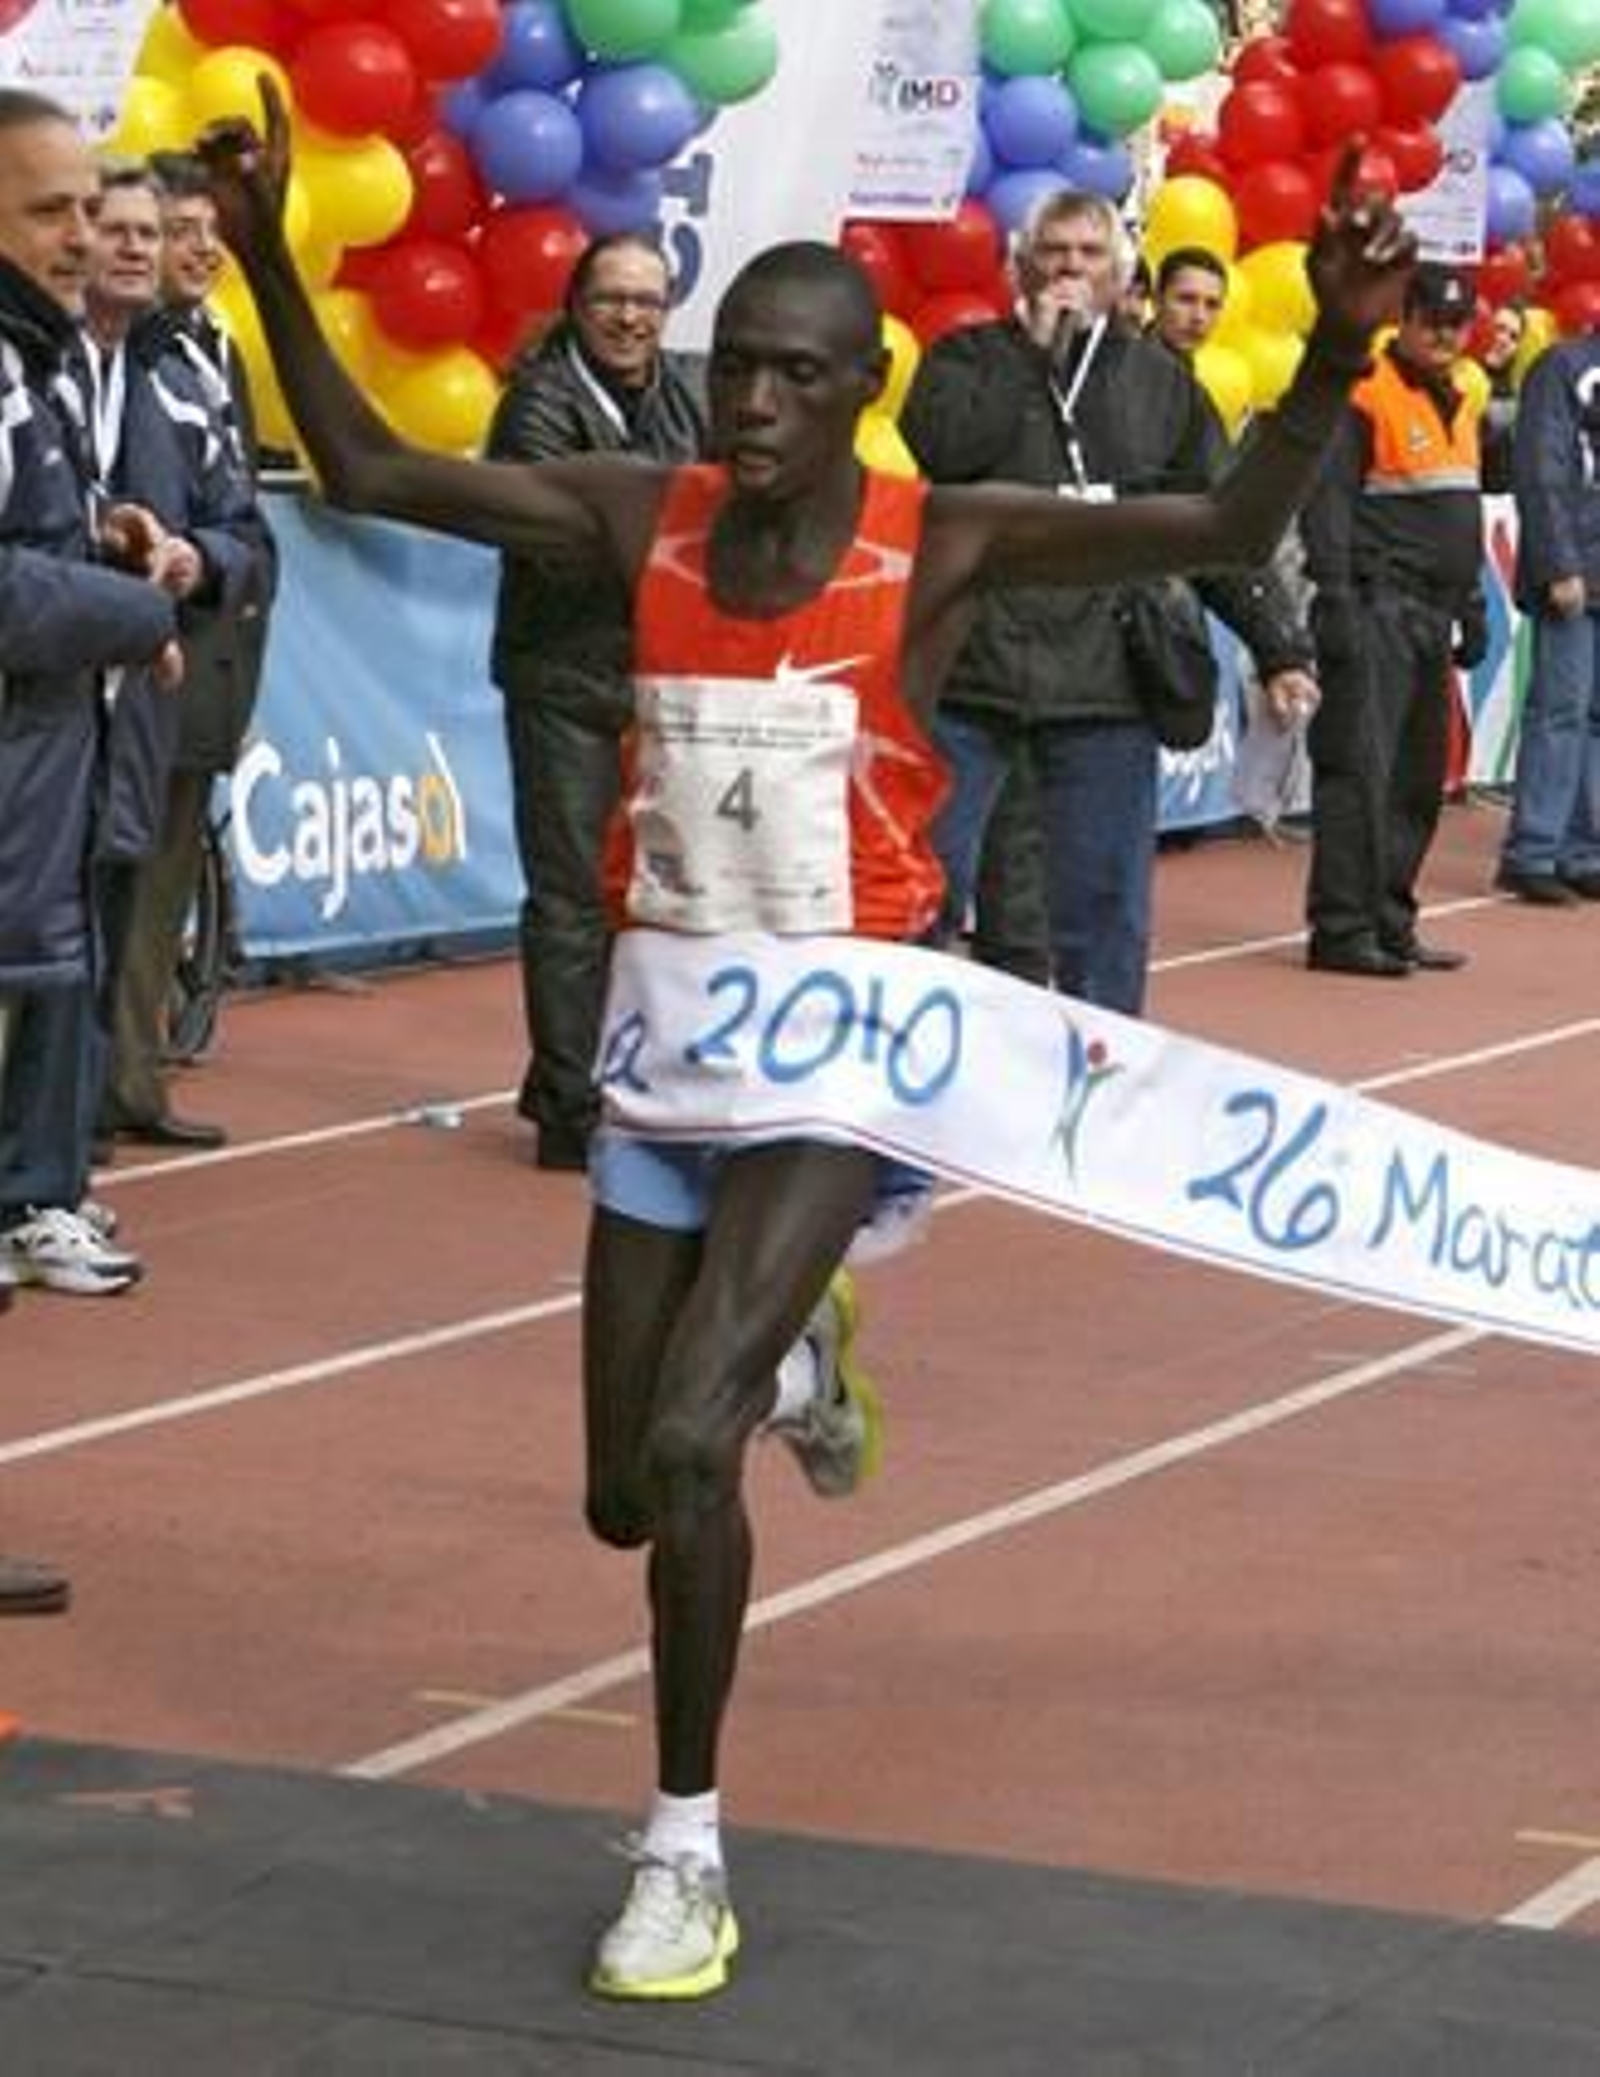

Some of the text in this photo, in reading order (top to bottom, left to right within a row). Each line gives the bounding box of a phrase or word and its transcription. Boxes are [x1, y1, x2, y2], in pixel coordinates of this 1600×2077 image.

[231, 731, 467, 920] Cajasol
[716, 767, 762, 832] 4
[684, 965, 963, 1104] 2010
